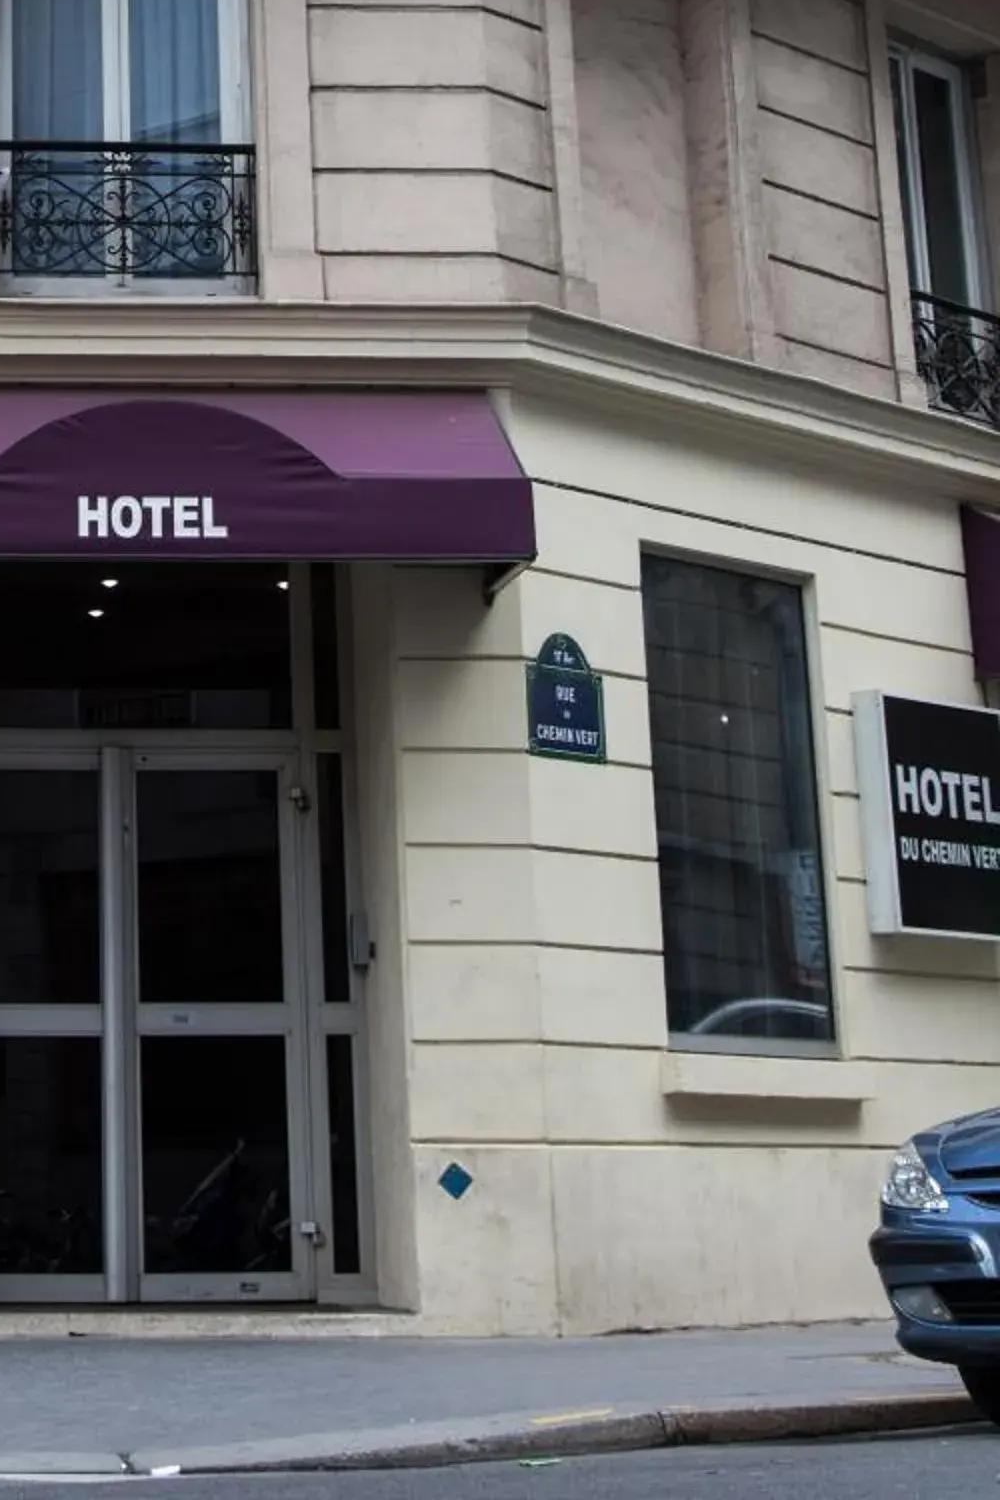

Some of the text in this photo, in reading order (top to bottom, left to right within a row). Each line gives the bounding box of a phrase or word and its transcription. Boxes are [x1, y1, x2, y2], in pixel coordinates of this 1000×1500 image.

[78, 495, 228, 538] HOTEL
[896, 763, 1000, 824] HOTEL
[900, 835, 919, 861] DU
[921, 839, 971, 868] CHEMIN
